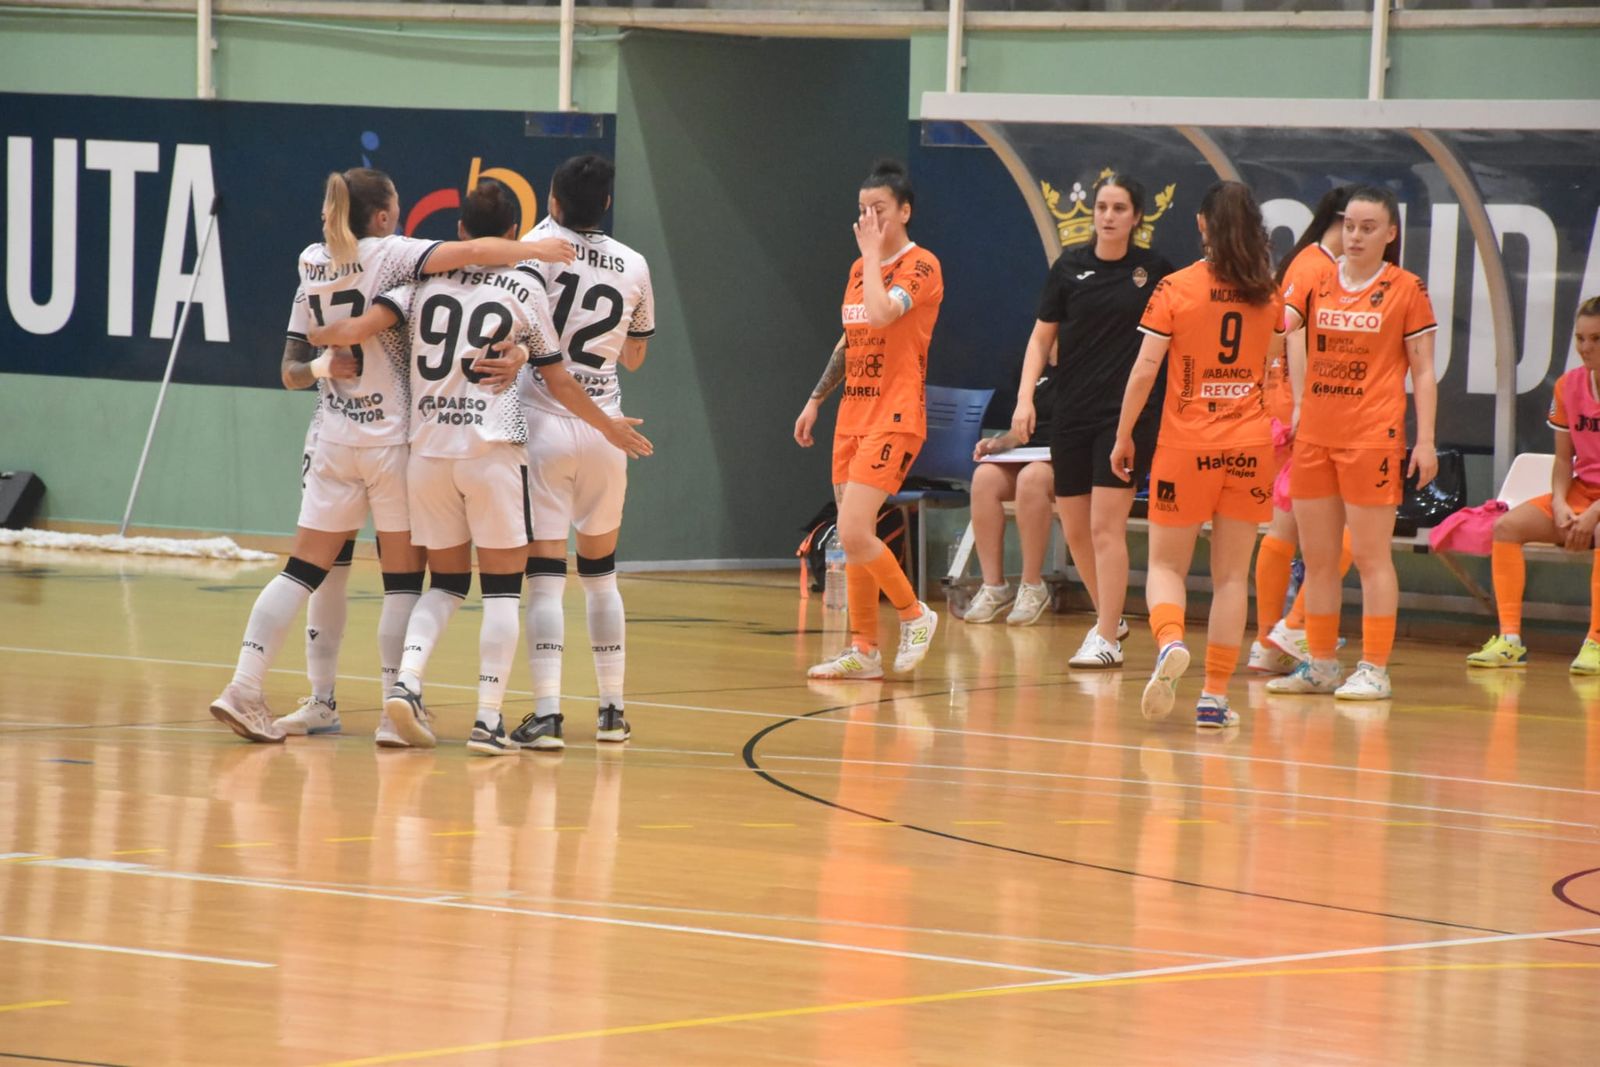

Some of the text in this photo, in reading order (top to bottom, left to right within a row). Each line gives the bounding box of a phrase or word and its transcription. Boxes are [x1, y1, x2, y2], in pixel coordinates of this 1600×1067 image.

[552, 271, 624, 369] 12
[1318, 312, 1379, 329] REYCO
[417, 294, 513, 384] 99
[1218, 311, 1243, 365] 9
[1203, 385, 1252, 396] REYCO
[1323, 384, 1364, 396] BURELA
[881, 443, 892, 461] 6
[1196, 452, 1257, 471] Halcón
[1379, 457, 1389, 476] 4
